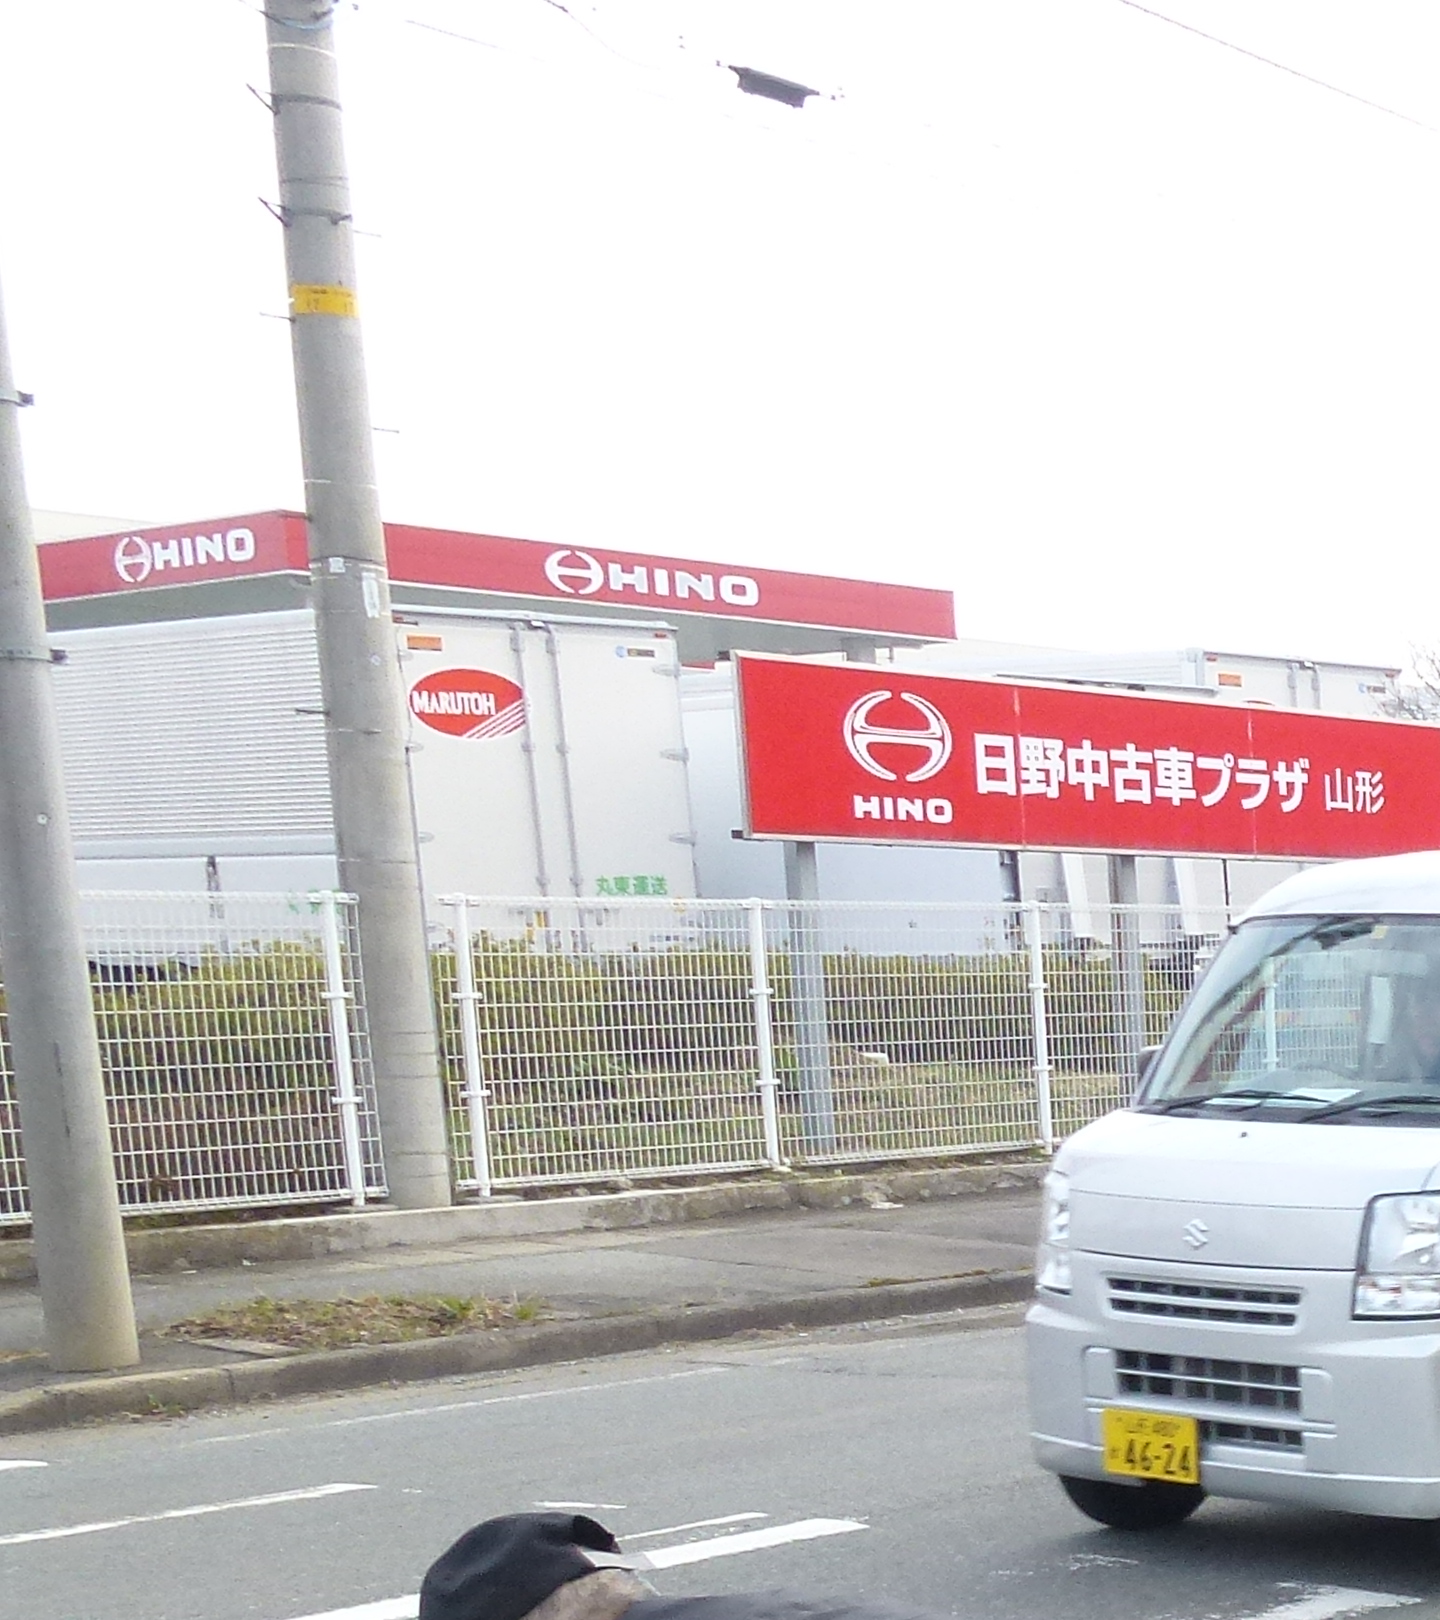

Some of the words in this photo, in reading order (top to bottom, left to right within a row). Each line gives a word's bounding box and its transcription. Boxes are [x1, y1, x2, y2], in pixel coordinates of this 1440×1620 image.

[152, 528, 255, 570] HINO
[607, 562, 759, 606] HINO
[411, 690, 497, 715] MARUTOH
[973, 732, 1310, 813] 日野中古車プラザ
[1323, 768, 1385, 814] 山形
[853, 795, 954, 824] HINO
[1124, 1438, 1190, 1478] 46-24
